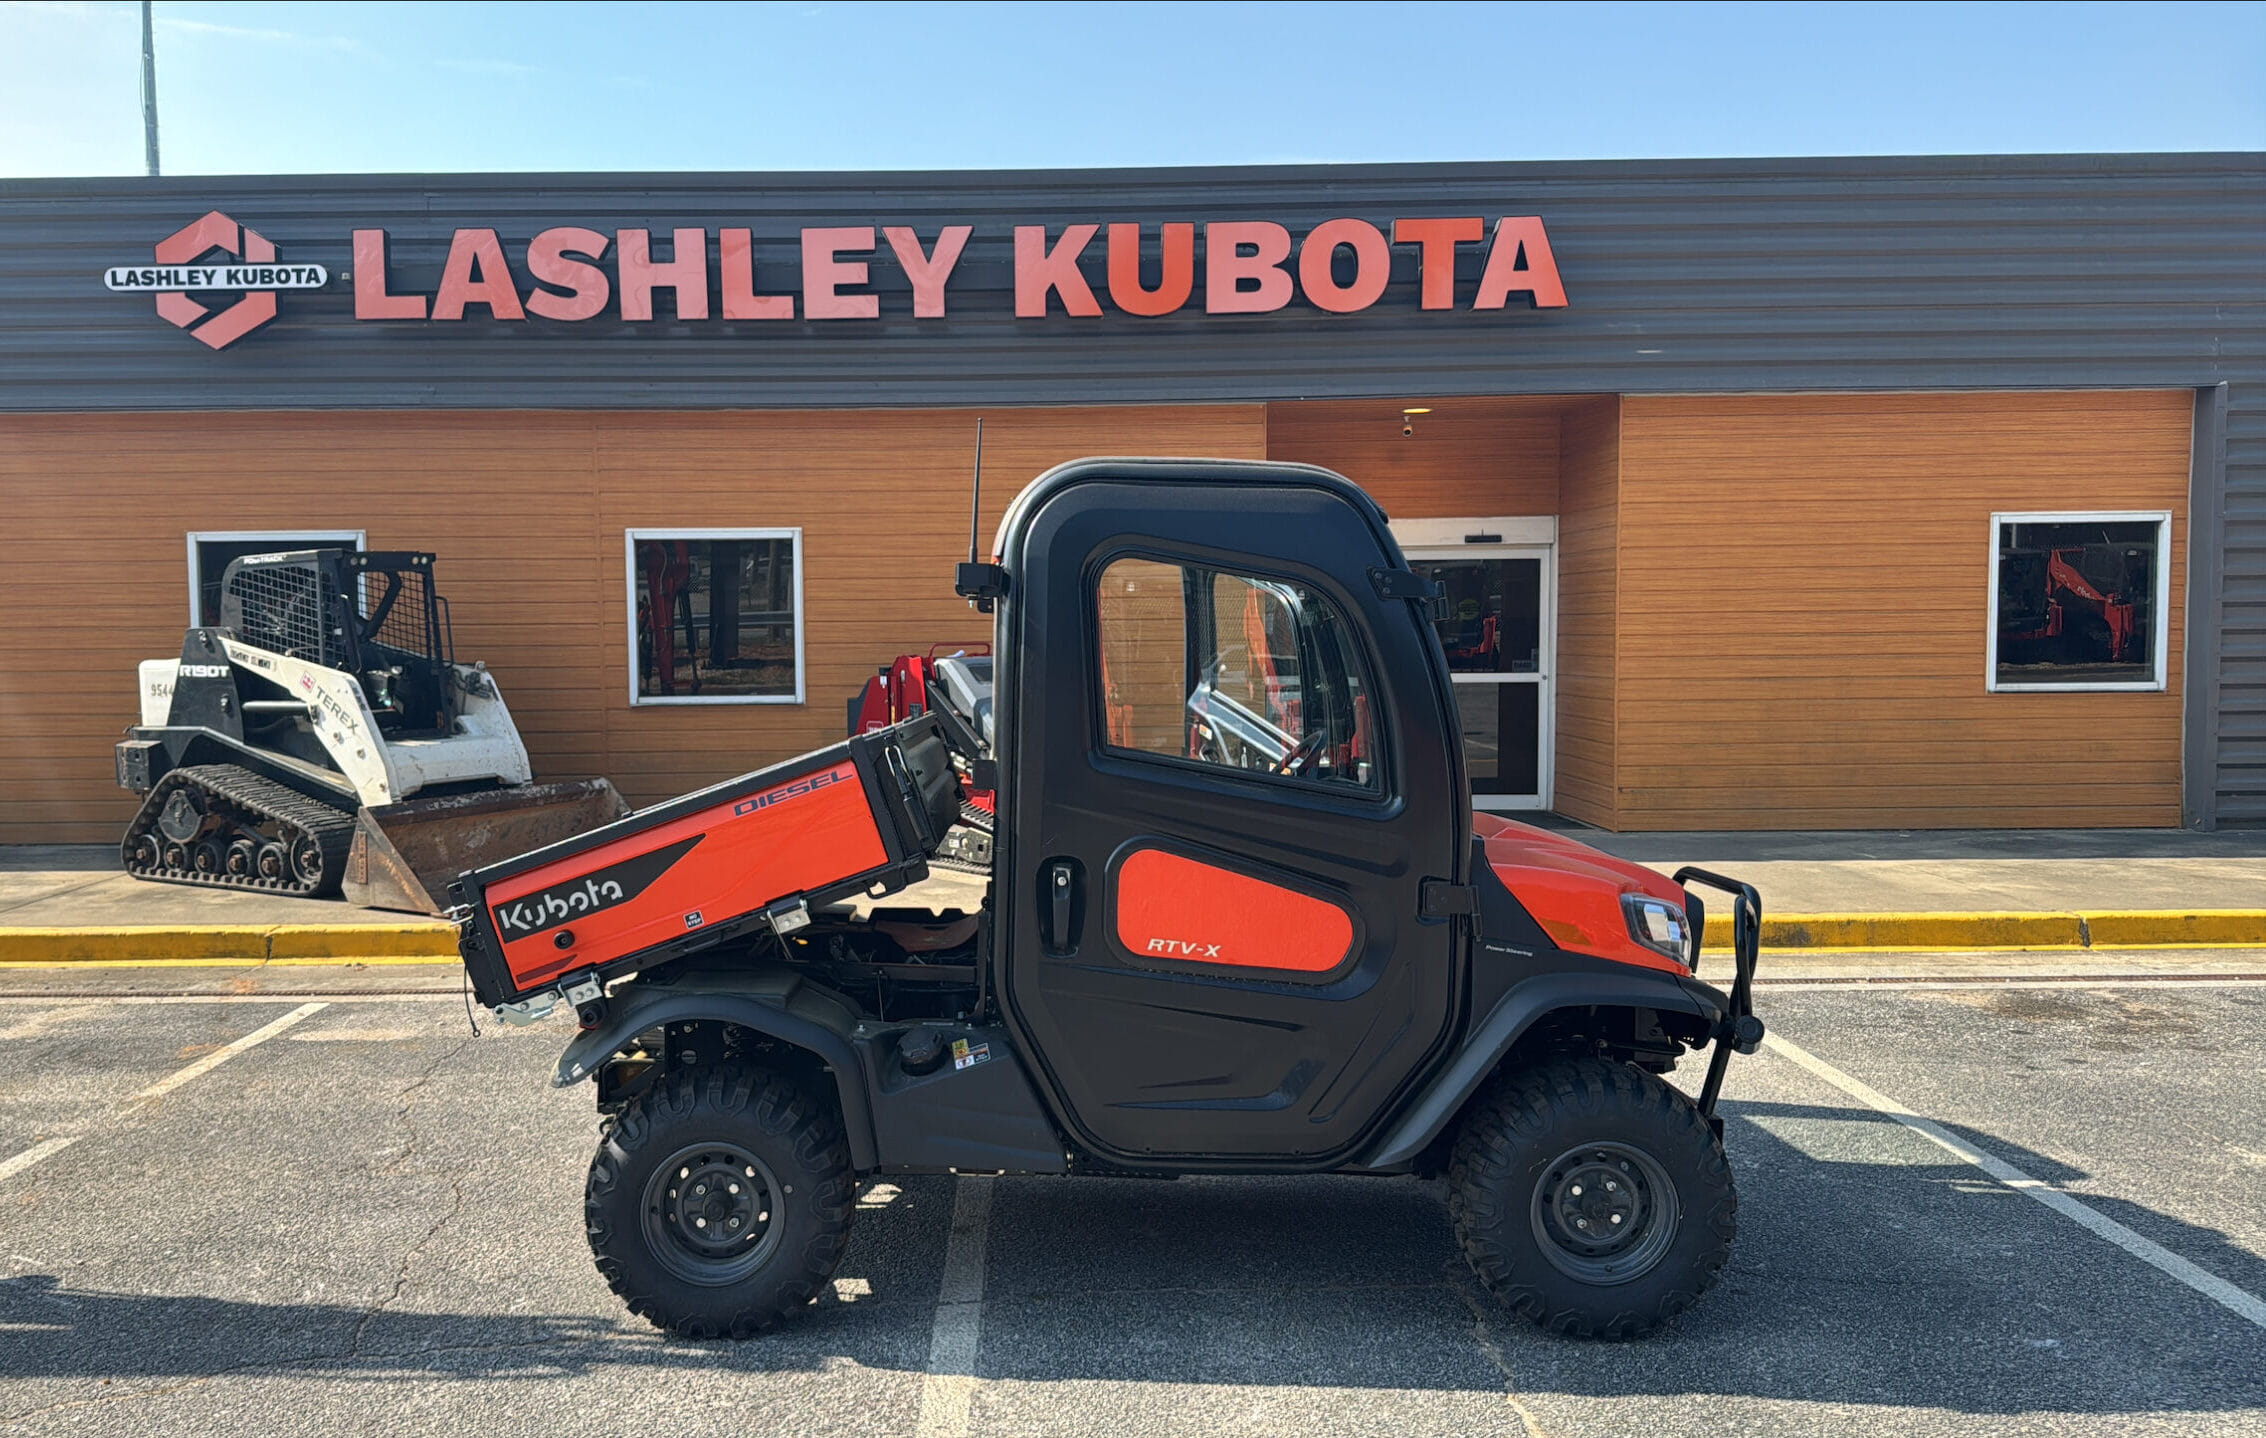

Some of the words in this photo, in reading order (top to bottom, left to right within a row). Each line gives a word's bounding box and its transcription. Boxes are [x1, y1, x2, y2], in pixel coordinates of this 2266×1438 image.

[111, 269, 217, 286] LASHLEY
[226, 268, 321, 286] KUBOTA
[351, 224, 974, 322] LASHLEY
[1013, 216, 1570, 318] KUBOTA
[315, 686, 359, 735] TEREX
[734, 771, 854, 816] DIESEL
[500, 879, 624, 930] Kubota
[1147, 938, 1222, 958] RTV-X
